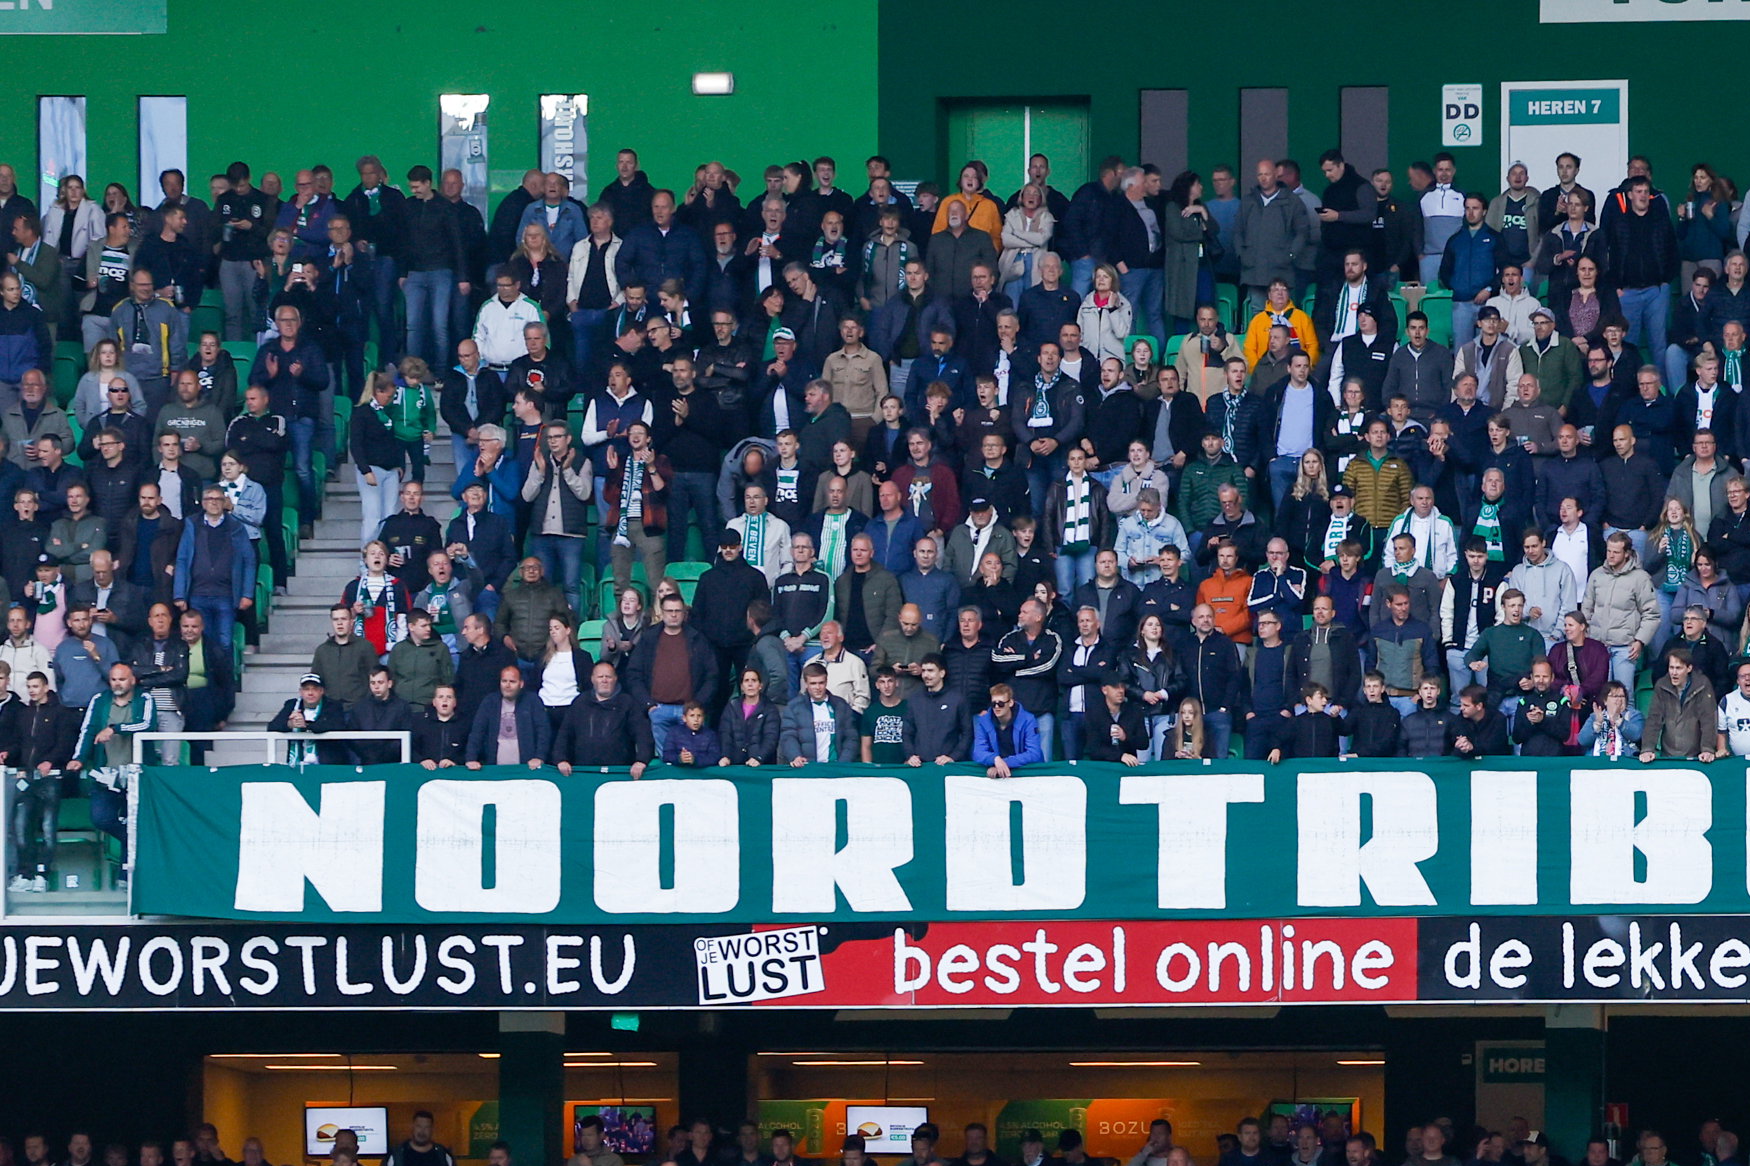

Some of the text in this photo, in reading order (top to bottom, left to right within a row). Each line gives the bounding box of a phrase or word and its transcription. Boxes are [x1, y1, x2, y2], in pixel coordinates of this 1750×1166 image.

[1445, 103, 1480, 120] DD
[1528, 99, 1602, 115] HEREN 7
[696, 929, 814, 961] OF WORST
[1444, 922, 1533, 990] de
[701, 951, 718, 964] JE
[894, 924, 1394, 995] bestel online
[701, 954, 817, 1001] LUST
[1489, 1057, 1546, 1074] HORE
